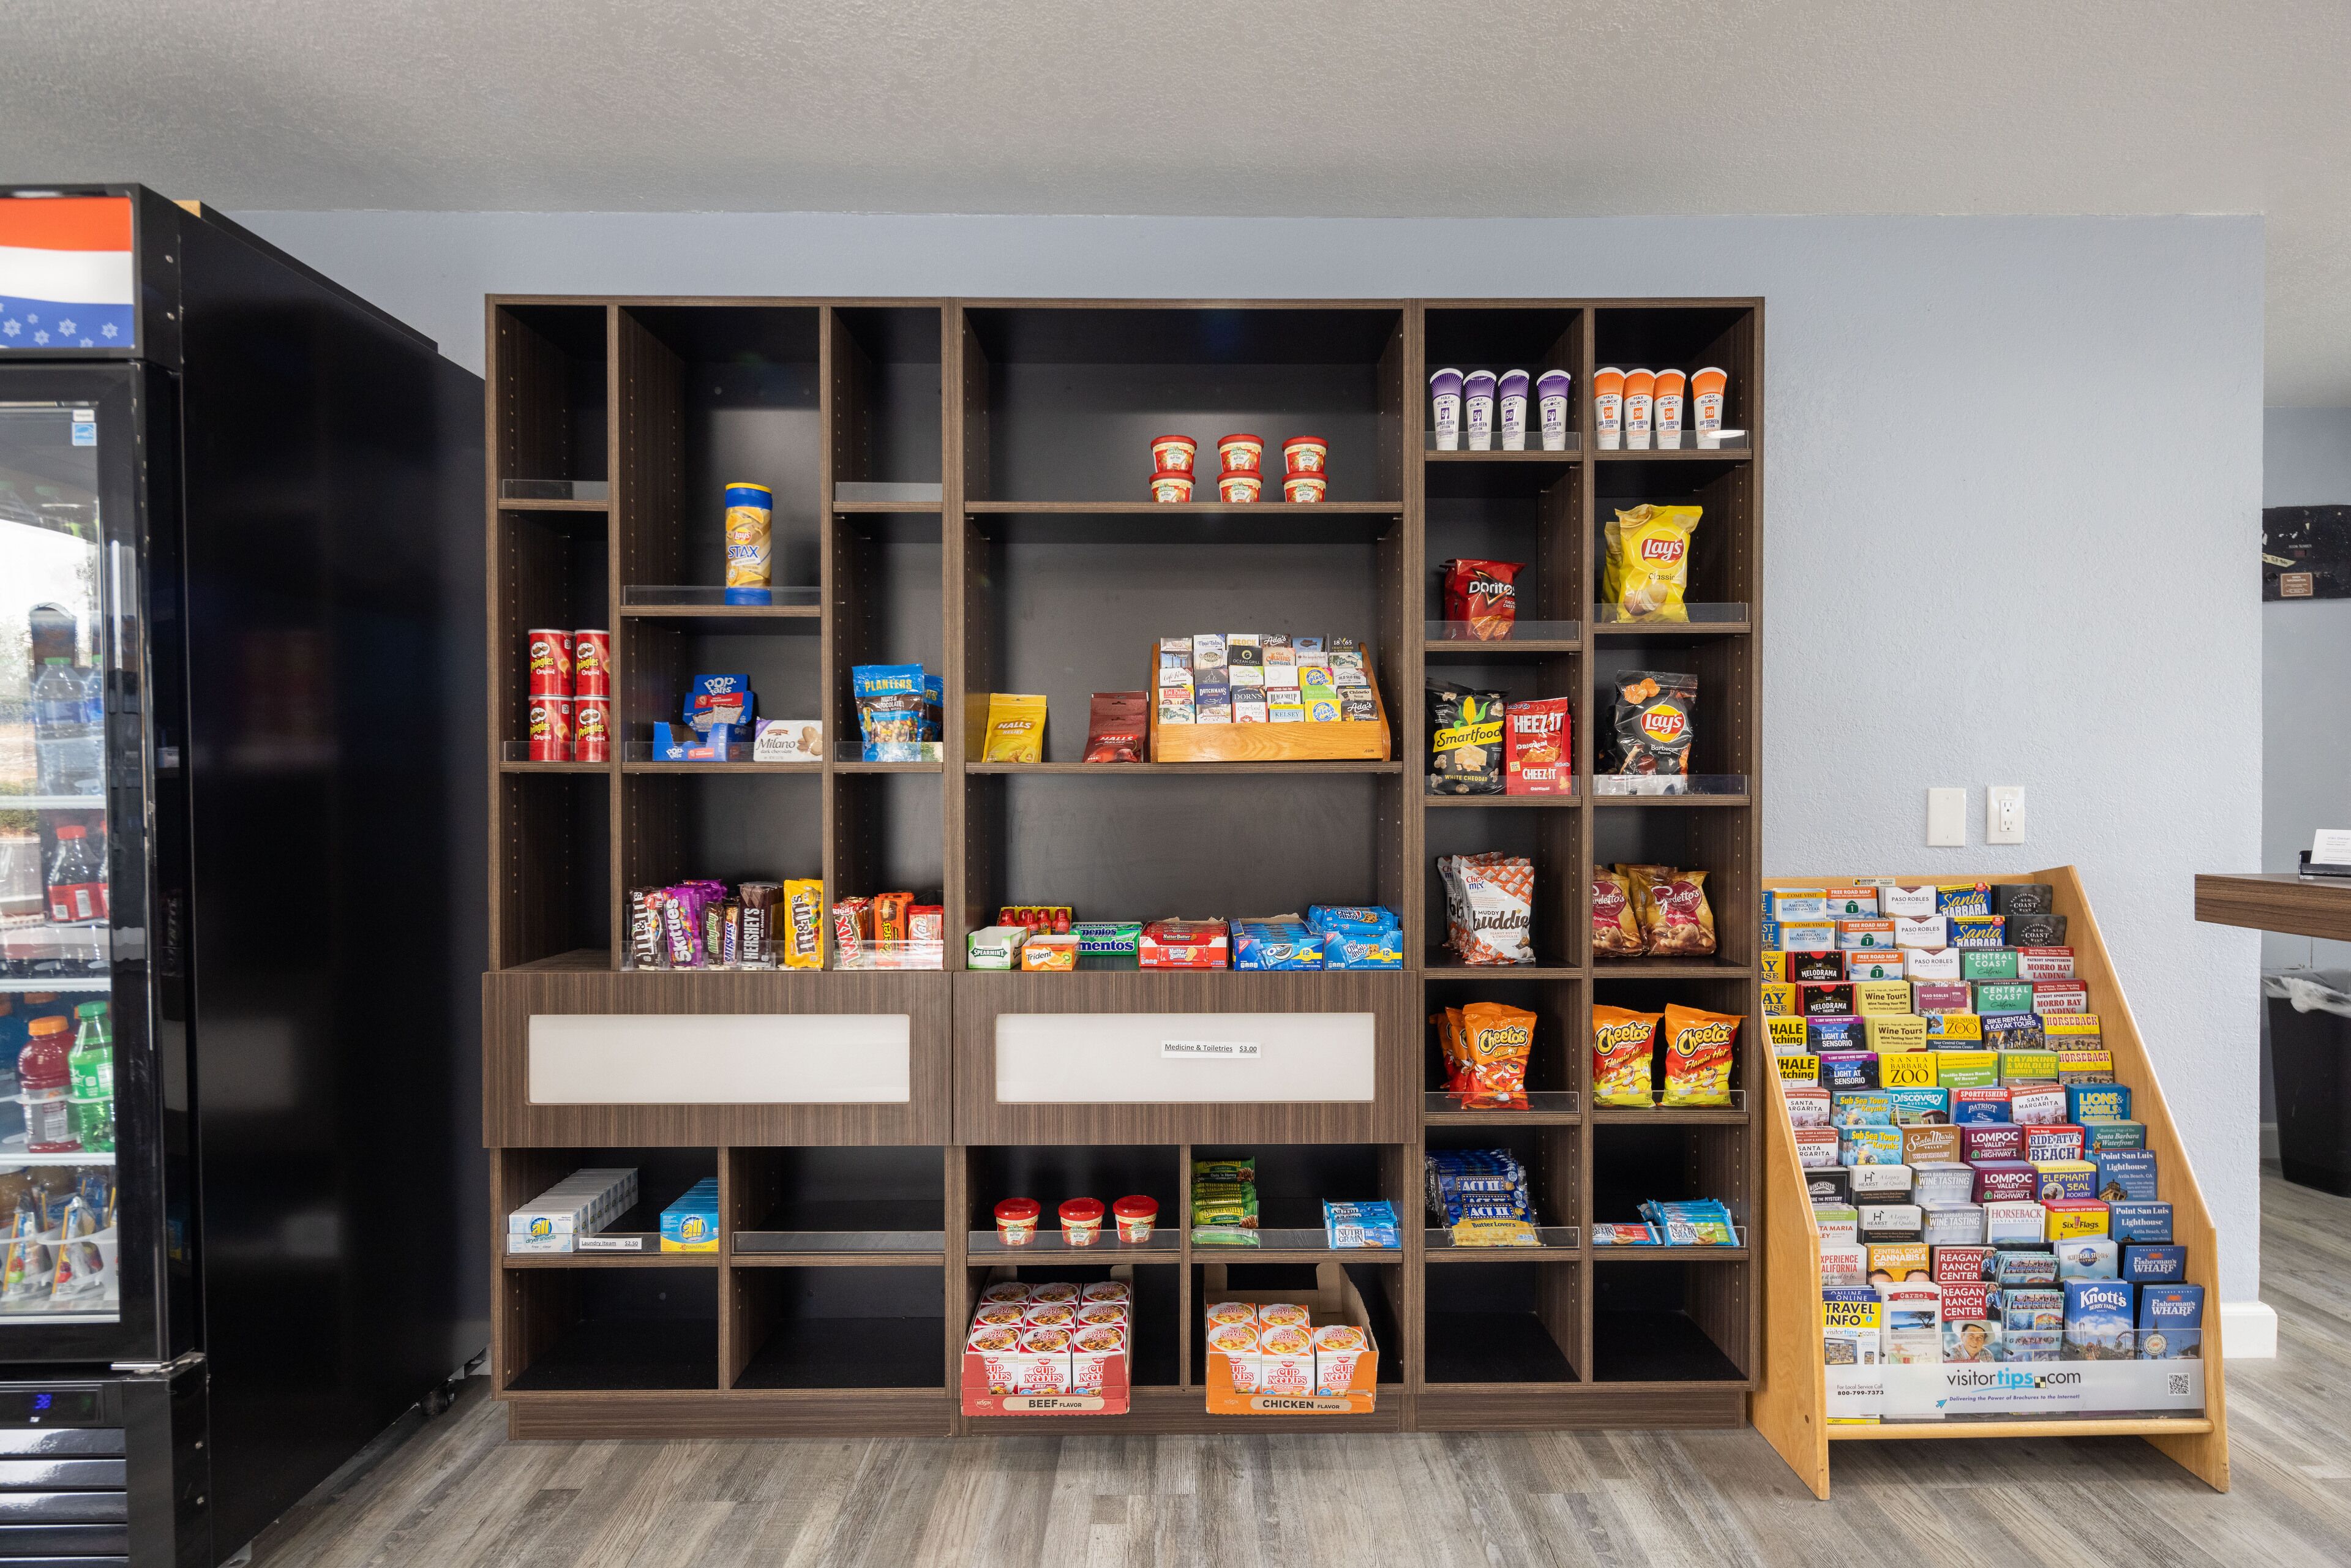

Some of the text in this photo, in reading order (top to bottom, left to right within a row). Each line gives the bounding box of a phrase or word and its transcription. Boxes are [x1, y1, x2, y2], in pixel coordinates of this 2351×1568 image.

[728, 545, 760, 558] STAX
[1644, 538, 1684, 561] Lay's
[1264, 636, 1286, 645] Ada's
[864, 679, 912, 692] PLANTERS
[1200, 687, 1226, 696] DUTCHMAN'S
[1348, 702, 1371, 713] Ada's
[1644, 714, 1683, 733] Lay's
[579, 723, 604, 740] Pringles
[1437, 726, 1501, 747] Smartfood
[756, 737, 795, 750] Milano
[667, 898, 692, 963] Skittles
[744, 908, 759, 960] HERSHEY'S
[835, 916, 860, 967] TWIX
[1078, 940, 1134, 951] mentos
[1026, 950, 1052, 961] Trident
[1478, 1026, 1529, 1054] Cheetos
[1595, 1021, 1652, 1056] Cheetos
[1712, 1048, 1729, 1058] Hot
[1891, 1069, 1929, 1083] ZOO
[1892, 1093, 1943, 1106] Discovery
[1968, 1104, 1997, 1113] PATRIOT
[2080, 1106, 2118, 1114] FOSSILS
[1971, 1132, 2019, 1143] LOMPOC
[2030, 1133, 2080, 1145] RIDE ATV's
[2031, 1147, 2076, 1161] BEACH
[1462, 1180, 1483, 1191] ACT
[1992, 1209, 2042, 1218] HORSEBACK
[532, 1218, 550, 1236] all
[681, 1218, 703, 1239] all
[1338, 1228, 1363, 1237] NUTRI
[1940, 1253, 1981, 1262] REAGAN
[1941, 1262, 1978, 1272] RANCH
[2134, 1264, 2176, 1274] WHARF
[1940, 1272, 1979, 1280] CENTER
[2080, 1287, 2127, 1308] Knott's
[1825, 1303, 1875, 1315] TRAVEL
[1825, 1315, 1861, 1326] INFO
[1033, 1365, 1056, 1375] CUP
[1277, 1368, 1300, 1377] CUP
[1024, 1373, 1064, 1384] NOODLES
[1268, 1376, 1308, 1385] NOODLES
[1029, 1399, 1058, 1408] BEEF
[1262, 1400, 1314, 1409] CHICKEN
